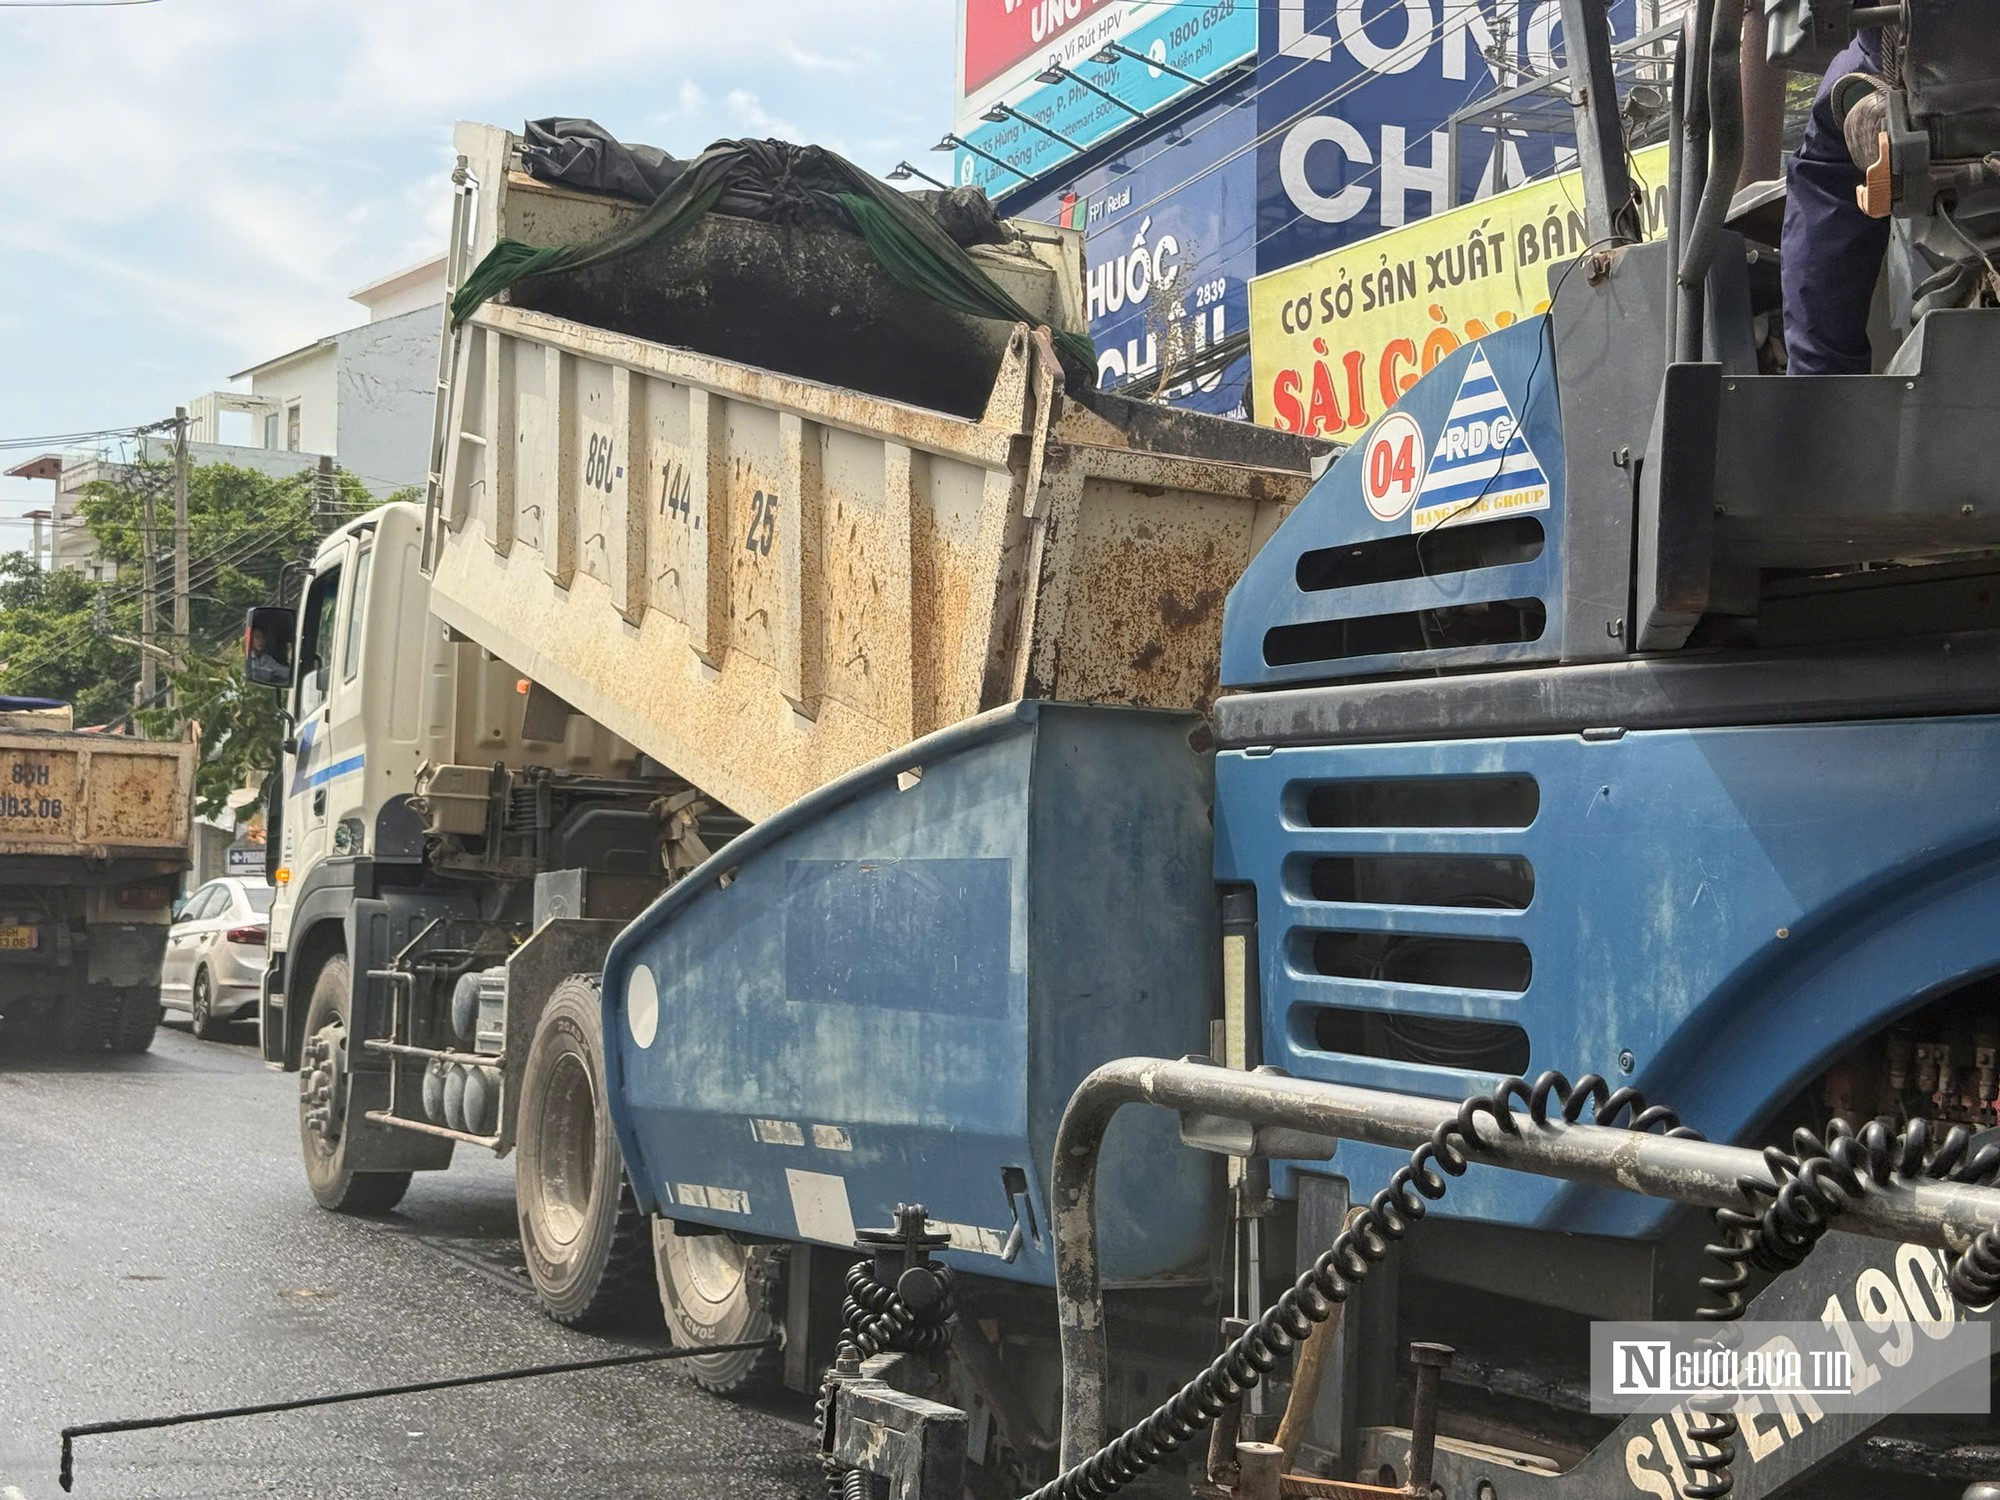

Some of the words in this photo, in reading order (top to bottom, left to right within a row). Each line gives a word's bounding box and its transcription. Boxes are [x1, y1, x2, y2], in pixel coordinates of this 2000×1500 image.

[1077, 27, 1096, 54] Rút
[1099, 9, 1122, 41] HPV
[1170, 17, 1199, 49] 1800
[1203, 0, 1234, 30] 6928
[1057, 95, 1066, 112] P.
[1279, 112, 1578, 227] CHÂ
[1089, 200, 1105, 223] FPT
[1107, 186, 1131, 214] Retail
[1196, 278, 1225, 308] 2839
[1281, 292, 1312, 335] CƠ
[1320, 267, 1353, 324] SỞ
[1361, 253, 1416, 312] SẢN
[1426, 218, 1505, 293] XUẤT
[1518, 204, 1590, 267] BÁN
[1446, 415, 1513, 462] RDG
[1370, 435, 1415, 498] 04
[746, 490, 778, 556] 25
[1494, 489, 1545, 509] GROUP
[1821, 1242, 1995, 1397] 190
